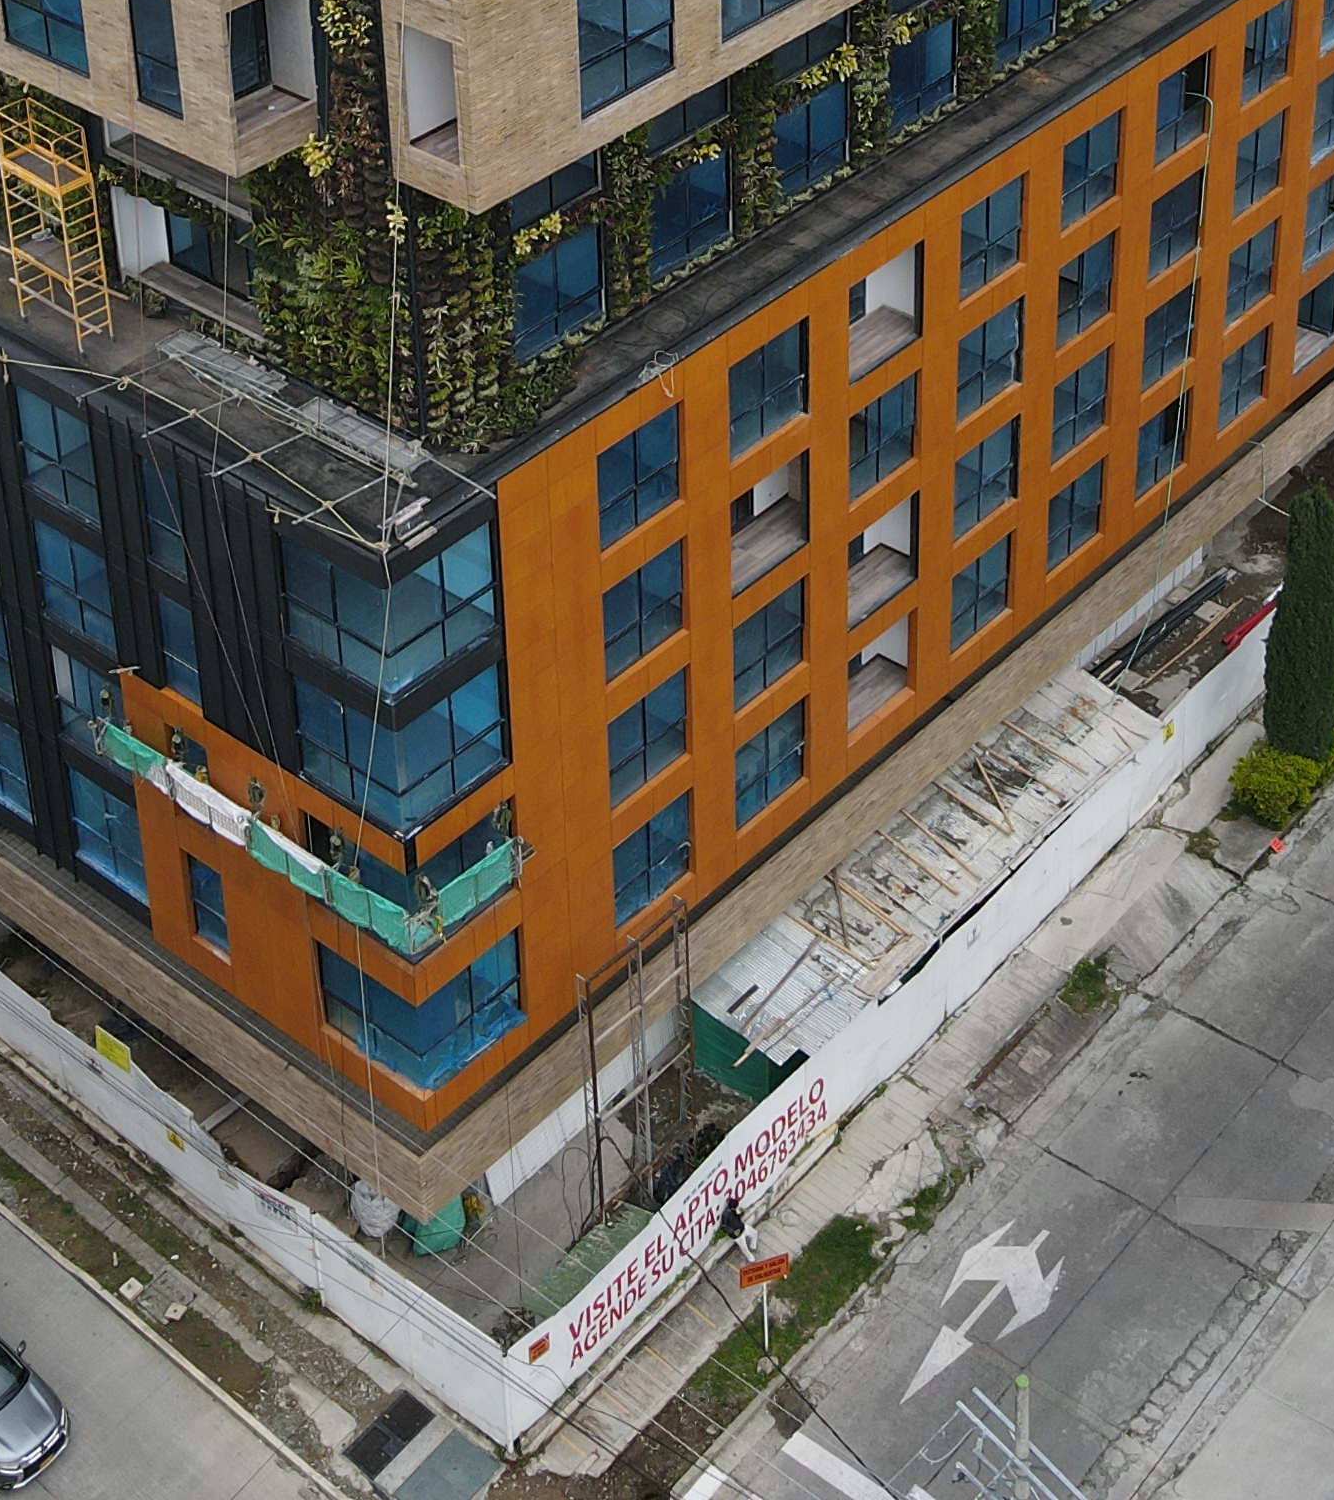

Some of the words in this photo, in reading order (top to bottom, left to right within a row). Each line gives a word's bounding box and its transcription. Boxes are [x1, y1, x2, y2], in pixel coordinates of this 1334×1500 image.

[568, 1257, 639, 1341] VISITE
[644, 1233, 668, 1269] EL
[673, 1168, 729, 1241] APTO
[734, 1077, 825, 1179] MODELO
[570, 1273, 647, 1369] AGENDE
[651, 1245, 675, 1287] SU
[678, 1204, 720, 1257] CITA:
